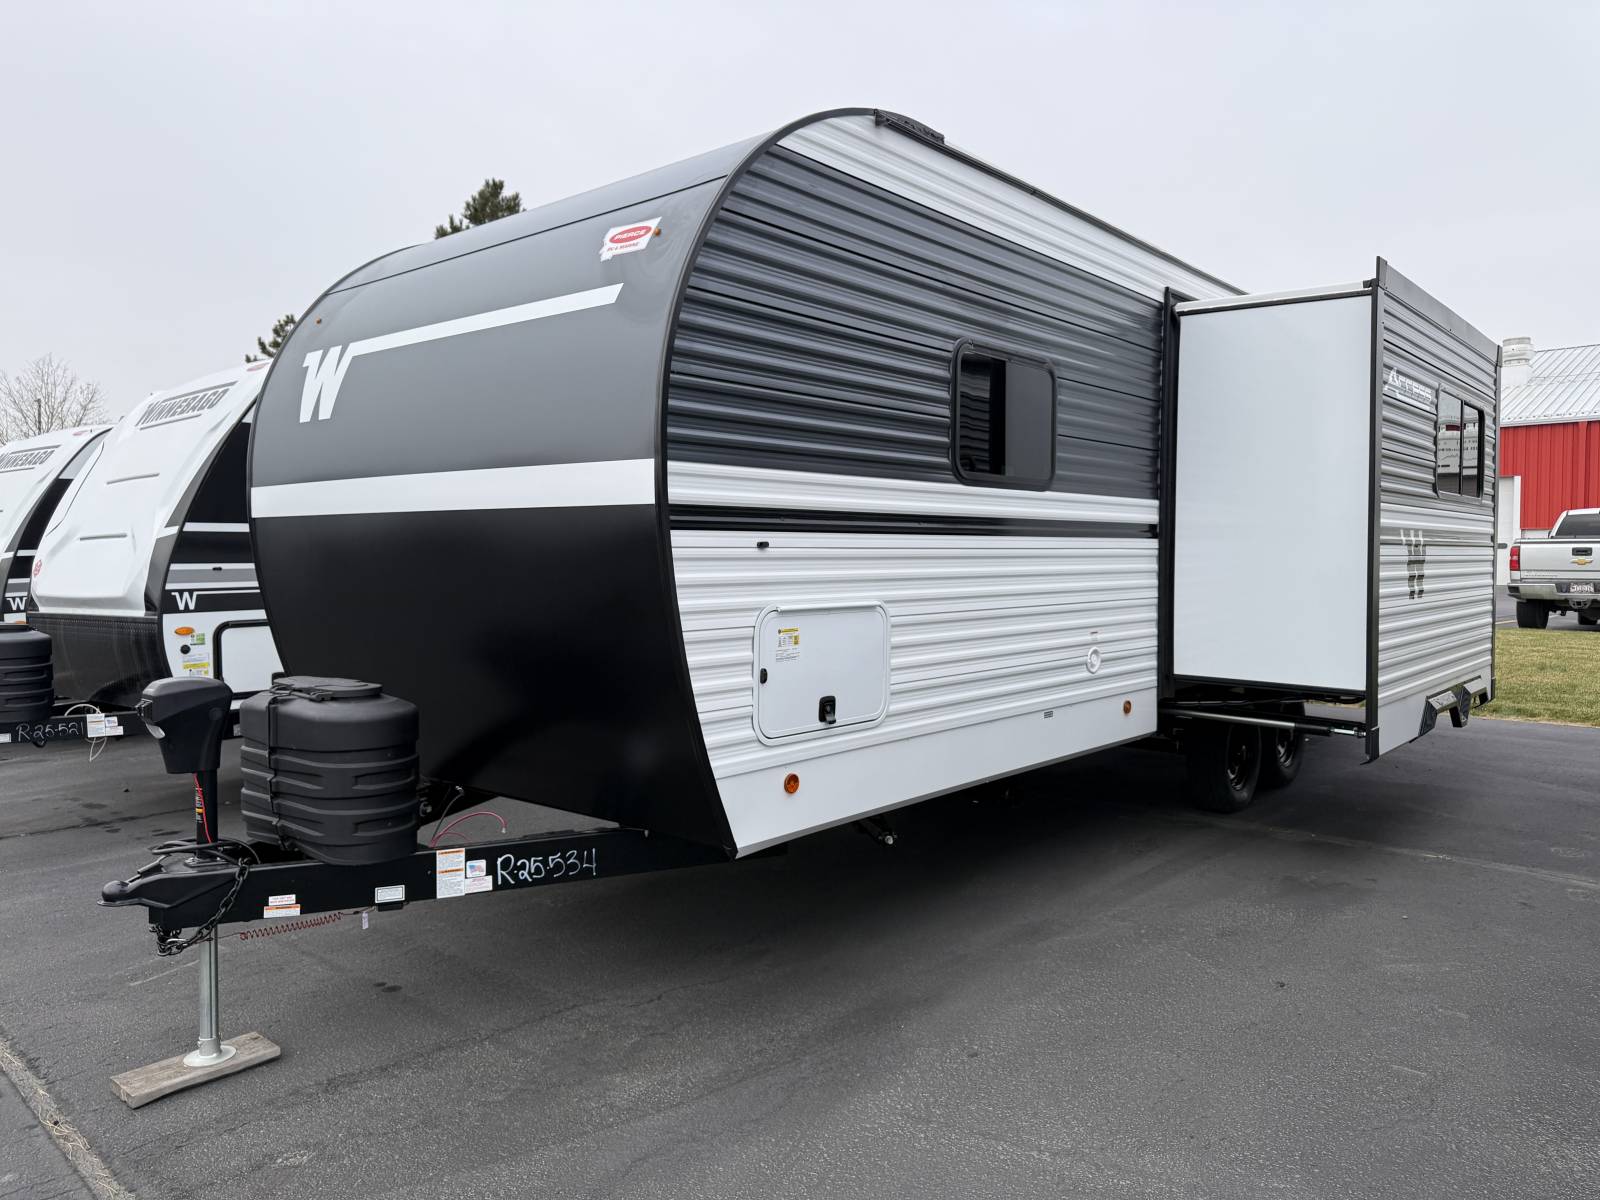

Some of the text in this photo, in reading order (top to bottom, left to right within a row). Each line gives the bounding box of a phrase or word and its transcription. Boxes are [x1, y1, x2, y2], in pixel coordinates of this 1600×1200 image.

[300, 344, 353, 424] W
[134, 388, 230, 428] WINNEBAGO
[6, 597, 28, 611] W
[171, 591, 197, 611] W
